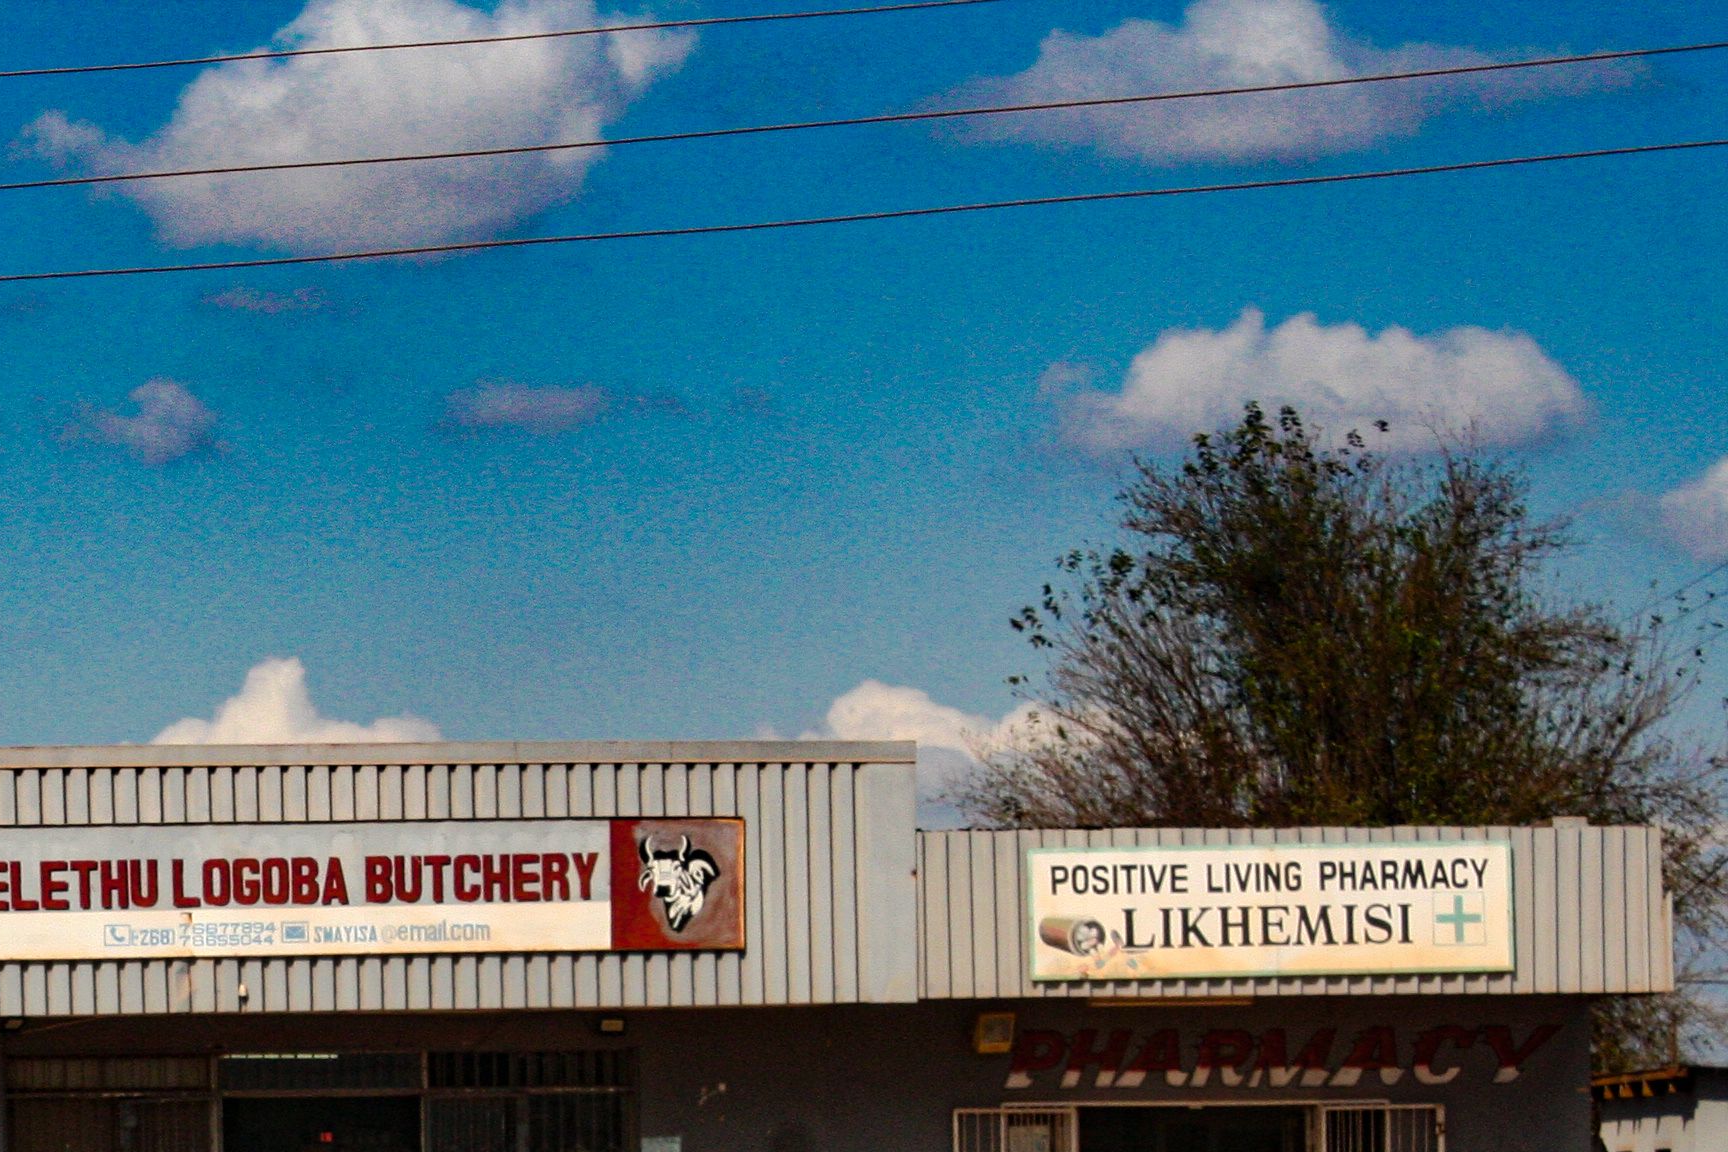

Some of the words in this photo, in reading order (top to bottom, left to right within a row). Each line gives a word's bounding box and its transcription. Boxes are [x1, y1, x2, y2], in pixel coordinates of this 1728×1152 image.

[172, 856, 349, 909] LOGOBA
[364, 852, 599, 904] BUTCHERY
[1051, 864, 1189, 895] POSITIVE
[1206, 862, 1302, 893] LIVING
[1319, 858, 1489, 891] PHARMACY
[1121, 902, 1414, 949] LIKHEMISI
[1003, 1022, 1562, 1089] PHARMACY
